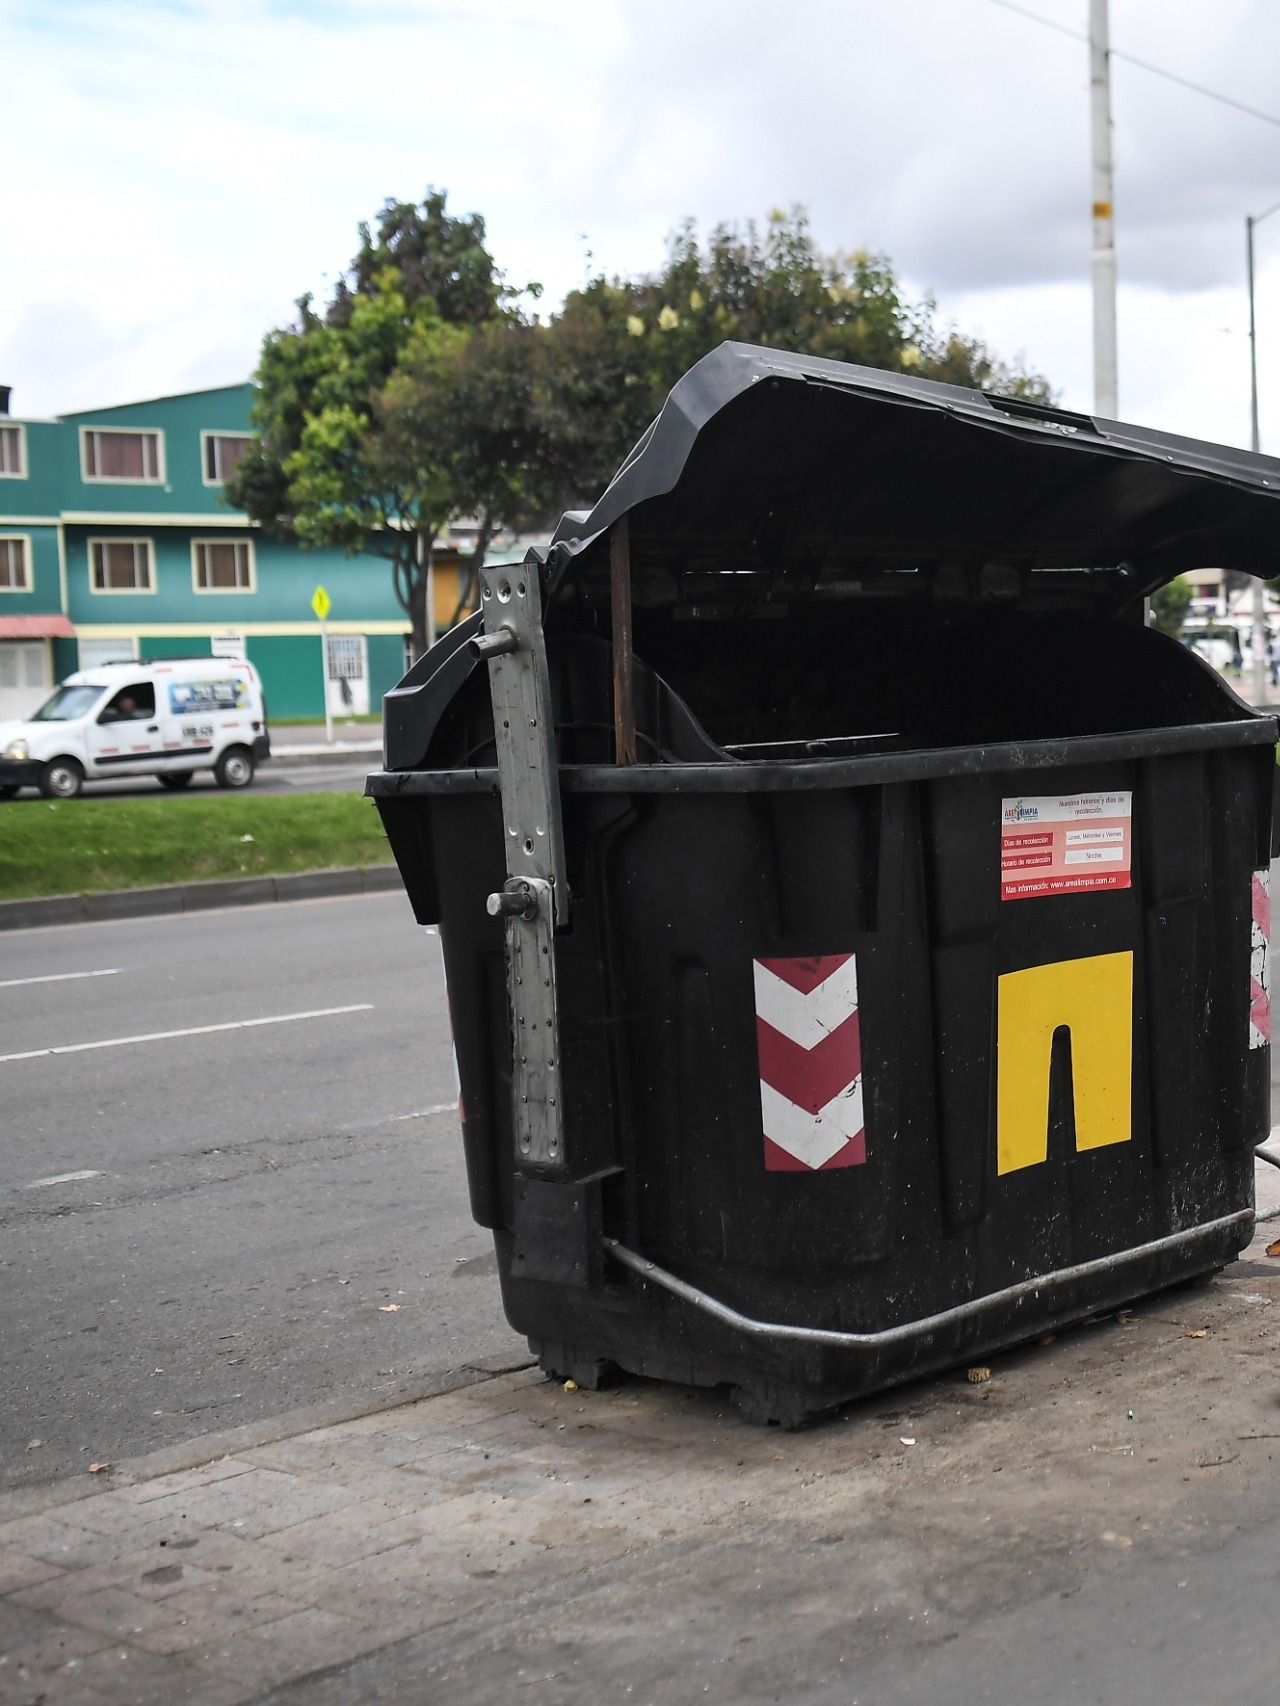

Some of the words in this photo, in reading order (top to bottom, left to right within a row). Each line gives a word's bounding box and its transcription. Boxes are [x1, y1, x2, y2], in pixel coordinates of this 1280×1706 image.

[1059, 799, 1079, 808] Nuestros
[1081, 797, 1100, 806] horarios
[1016, 838, 1022, 846] de
[1022, 836, 1049, 845] recolección
[1068, 833, 1081, 841] Lunes,
[1105, 830, 1121, 838] Viernes
[1001, 858, 1017, 868] Horario
[1018, 857, 1024, 866] de
[1025, 855, 1050, 865] recolección
[1086, 852, 1101, 860] Noche
[1050, 876, 1117, 889] www.arealimpia.com.co
